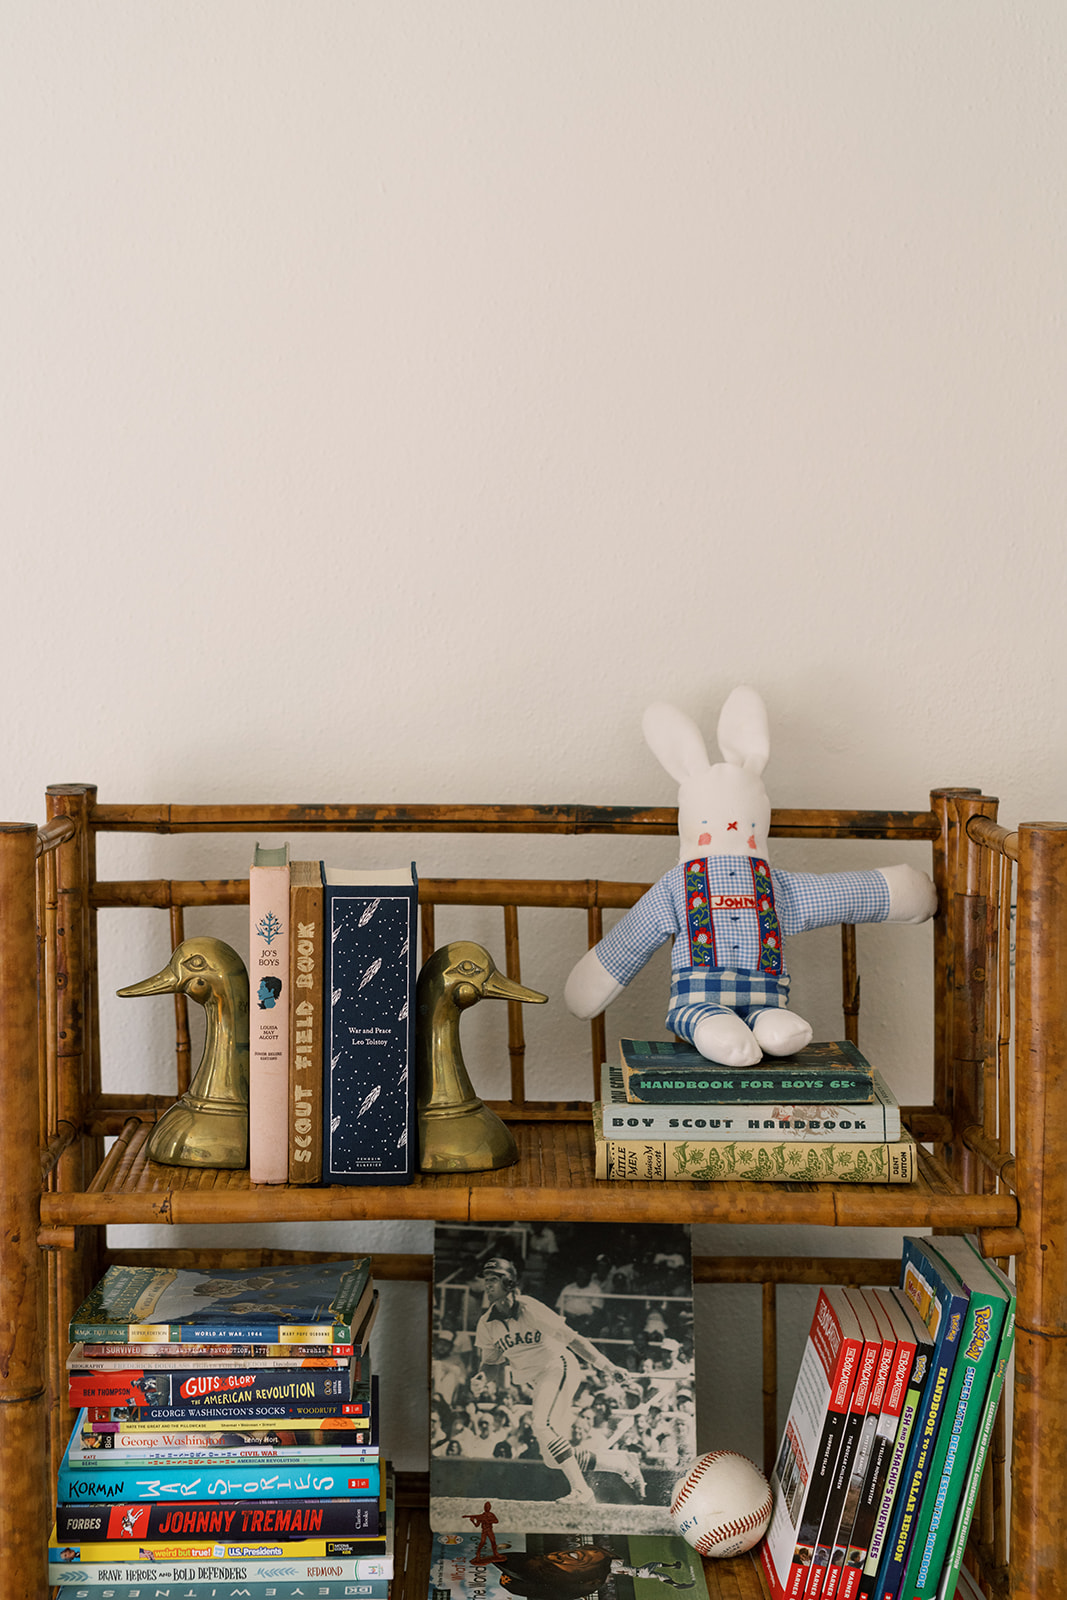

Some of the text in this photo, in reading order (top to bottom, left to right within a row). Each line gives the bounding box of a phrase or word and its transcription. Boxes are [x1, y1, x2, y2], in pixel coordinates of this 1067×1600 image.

[714, 896, 755, 908] JOHN
[258, 958, 280, 966] BOYS
[261, 949, 278, 958] JO'S
[294, 922, 315, 1163] SCOUT FIELD BOOK
[365, 1038, 388, 1047] Tolstoy
[640, 1080, 734, 1089] HANDBOOK
[741, 1080, 774, 1089] FOR
[781, 1080, 824, 1089] BOYS
[612, 1118, 867, 1130] BOY SCOUT HANDBOOK
[616, 1146, 627, 1179] LITTLE
[627, 1151, 638, 1177] MEN
[643, 1155, 654, 1179] Louisa
[653, 1149, 663, 1178] Alcott
[74, 1329, 92, 1337] MAGIC
[105, 1345, 141, 1354] SURVIVED
[298, 1346, 326, 1354] Tarshis
[839, 1346, 857, 1386] THE BOXCAR
[860, 1348, 877, 1386] THE BOXCAR
[876, 1347, 893, 1386] THE BOXCAR
[894, 1349, 911, 1387] THE BOXCAR
[83, 1388, 131, 1396] BEN THOMPSON
[185, 1375, 257, 1396] GUTS GLORY
[203, 1390, 253, 1405] AMERICAN
[256, 1381, 316, 1400] REVOLUTION
[151, 1406, 286, 1418] GEORGE WASHINGTON'S SOCKS
[984, 1401, 996, 1434] LEGENDARY
[121, 1435, 226, 1448] George Washington
[244, 1436, 262, 1444] Lenny
[820, 1433, 834, 1476] SURPRISE ISLAND
[842, 1445, 851, 1465] BOXCAR
[876, 1446, 885, 1466] YELLOW
[893, 1366, 949, 1563] HANDBOOK TO THE GALAR REGION
[974, 1445, 985, 1473] MYTHICAL
[135, 1473, 335, 1498] WAR STORIES
[836, 1465, 847, 1490] CHILDREN
[870, 1406, 914, 1559] ASH AND PIKACHU'S ADVENTURES
[872, 1466, 881, 1483] HOUSE
[915, 1366, 976, 1589] SUPER EXTRA DELUXE ESSENTIAL HANDBOOK
[68, 1480, 125, 1498] KORMAN
[867, 1483, 876, 1505] MYSTERY
[66, 1518, 102, 1531] FORBES
[158, 1508, 324, 1534] JOHNNY TREMAIN
[963, 1506, 972, 1526] SUPER
[958, 1525, 968, 1546] DELUXE
[153, 1547, 212, 1558] weird but true!
[228, 1547, 283, 1556] U.S. Presidents
[953, 1546, 963, 1570] EDITION
[98, 1568, 123, 1582] BRAVE
[125, 1568, 158, 1582] HEROES
[173, 1567, 196, 1582] BOLD
[198, 1566, 248, 1580] DEFENDERS
[307, 1566, 343, 1577] REDMOND
[451, 1556, 466, 1582] What Is
[467, 1565, 488, 1589] World
[75, 1587, 330, 1598] EYEWITNESS
[791, 1567, 803, 1596] WARNER
[810, 1568, 822, 1596] WARNER
[827, 1568, 838, 1597] WARNER
[843, 1570, 856, 1599] WARNER
